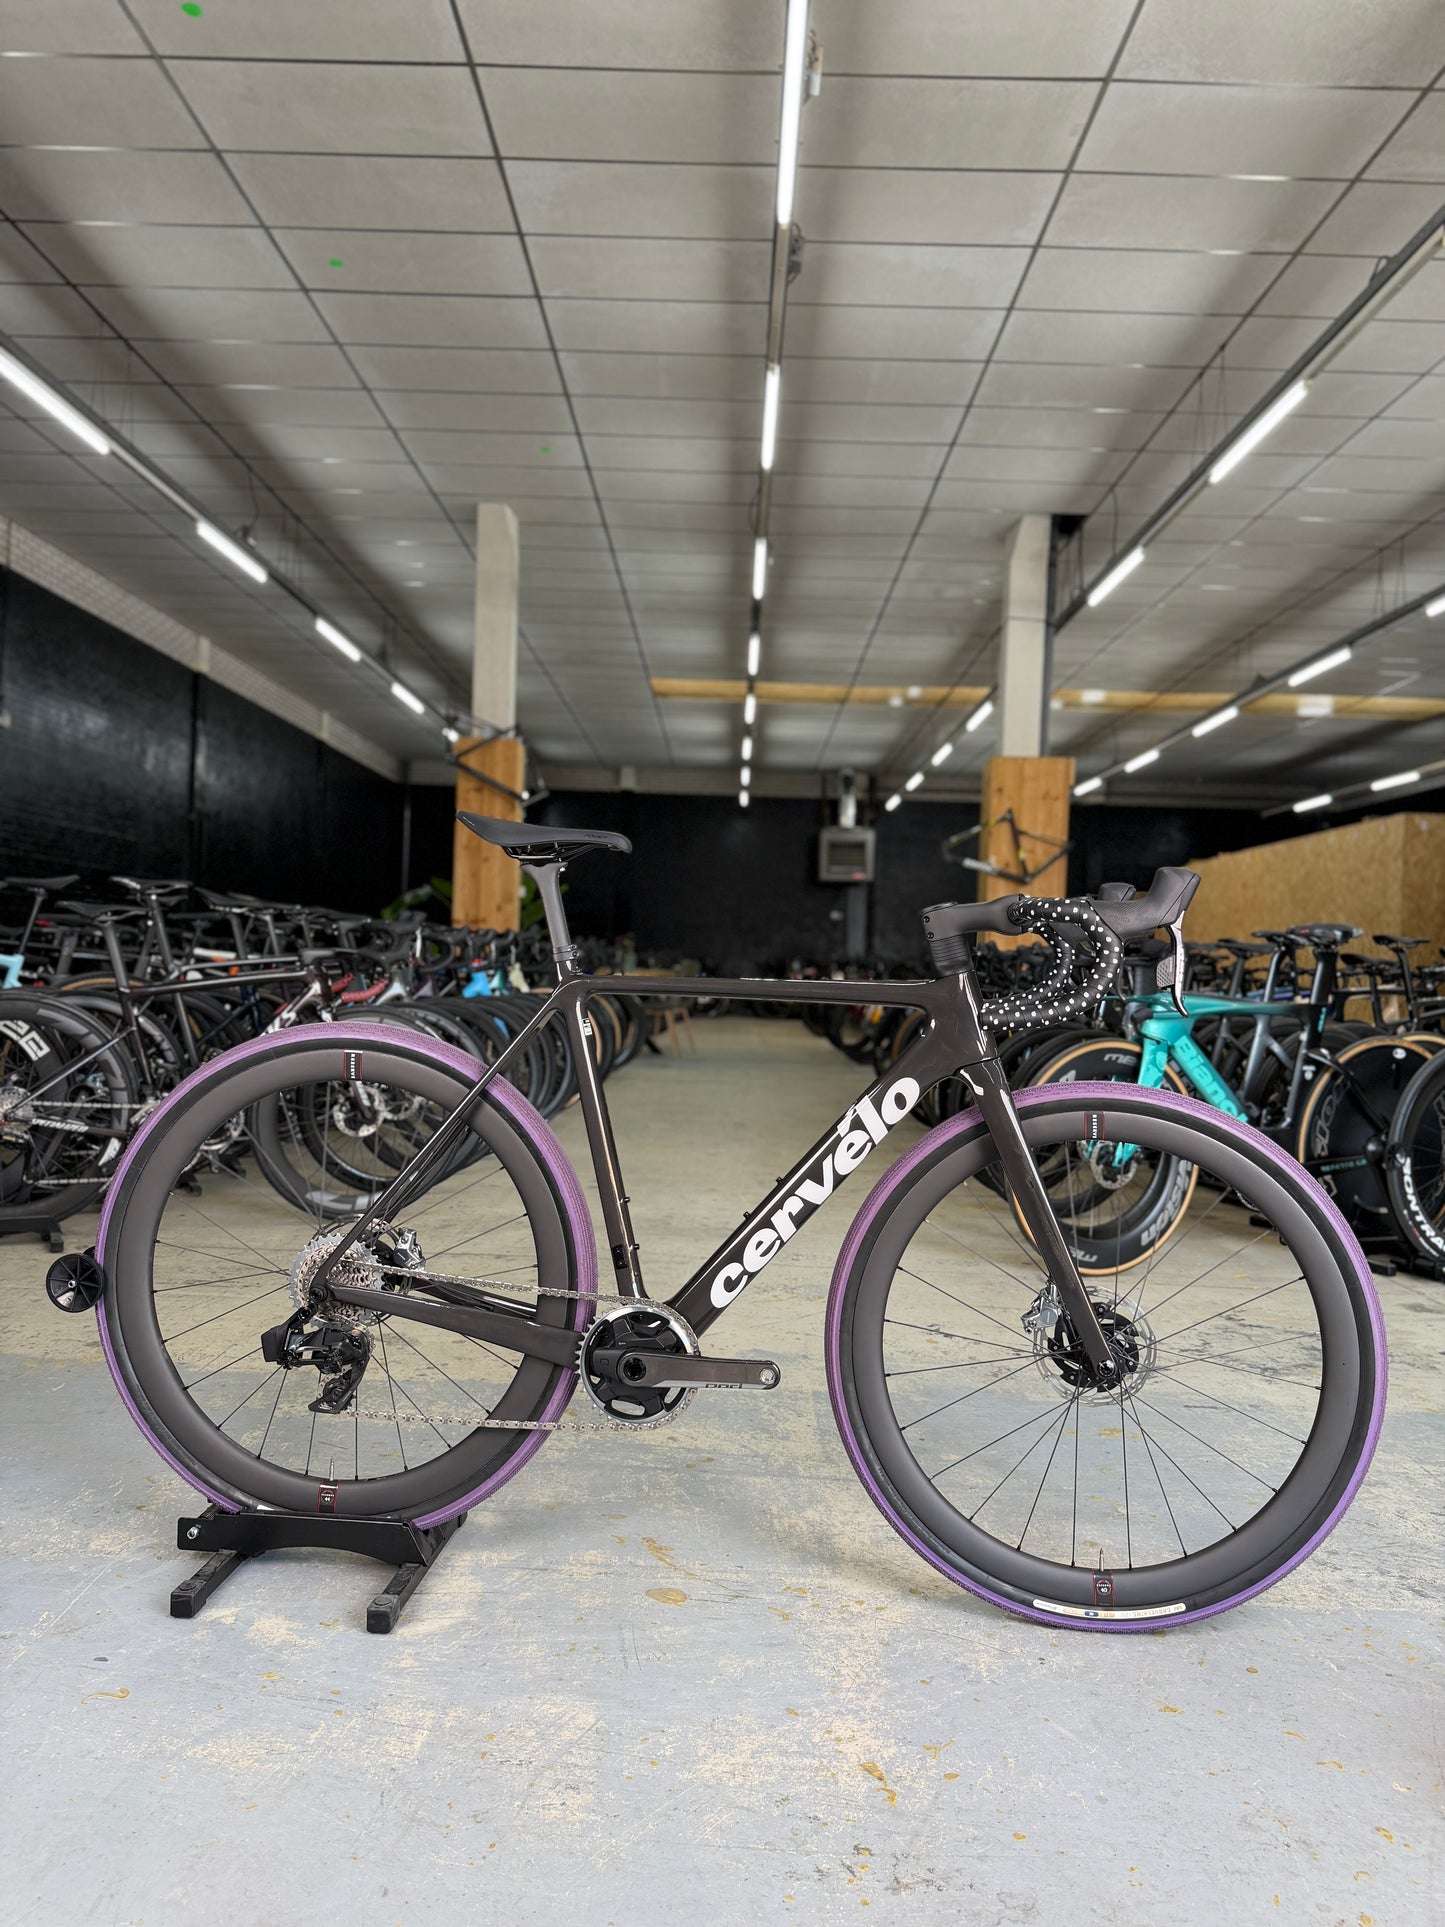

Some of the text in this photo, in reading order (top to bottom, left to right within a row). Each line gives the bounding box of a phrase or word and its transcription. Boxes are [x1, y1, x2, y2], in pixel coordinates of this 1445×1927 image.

[1173, 1035, 1248, 1123] Bianc
[710, 1077, 920, 1308] cervélo
[1402, 1156, 1445, 1250] BONTRA
